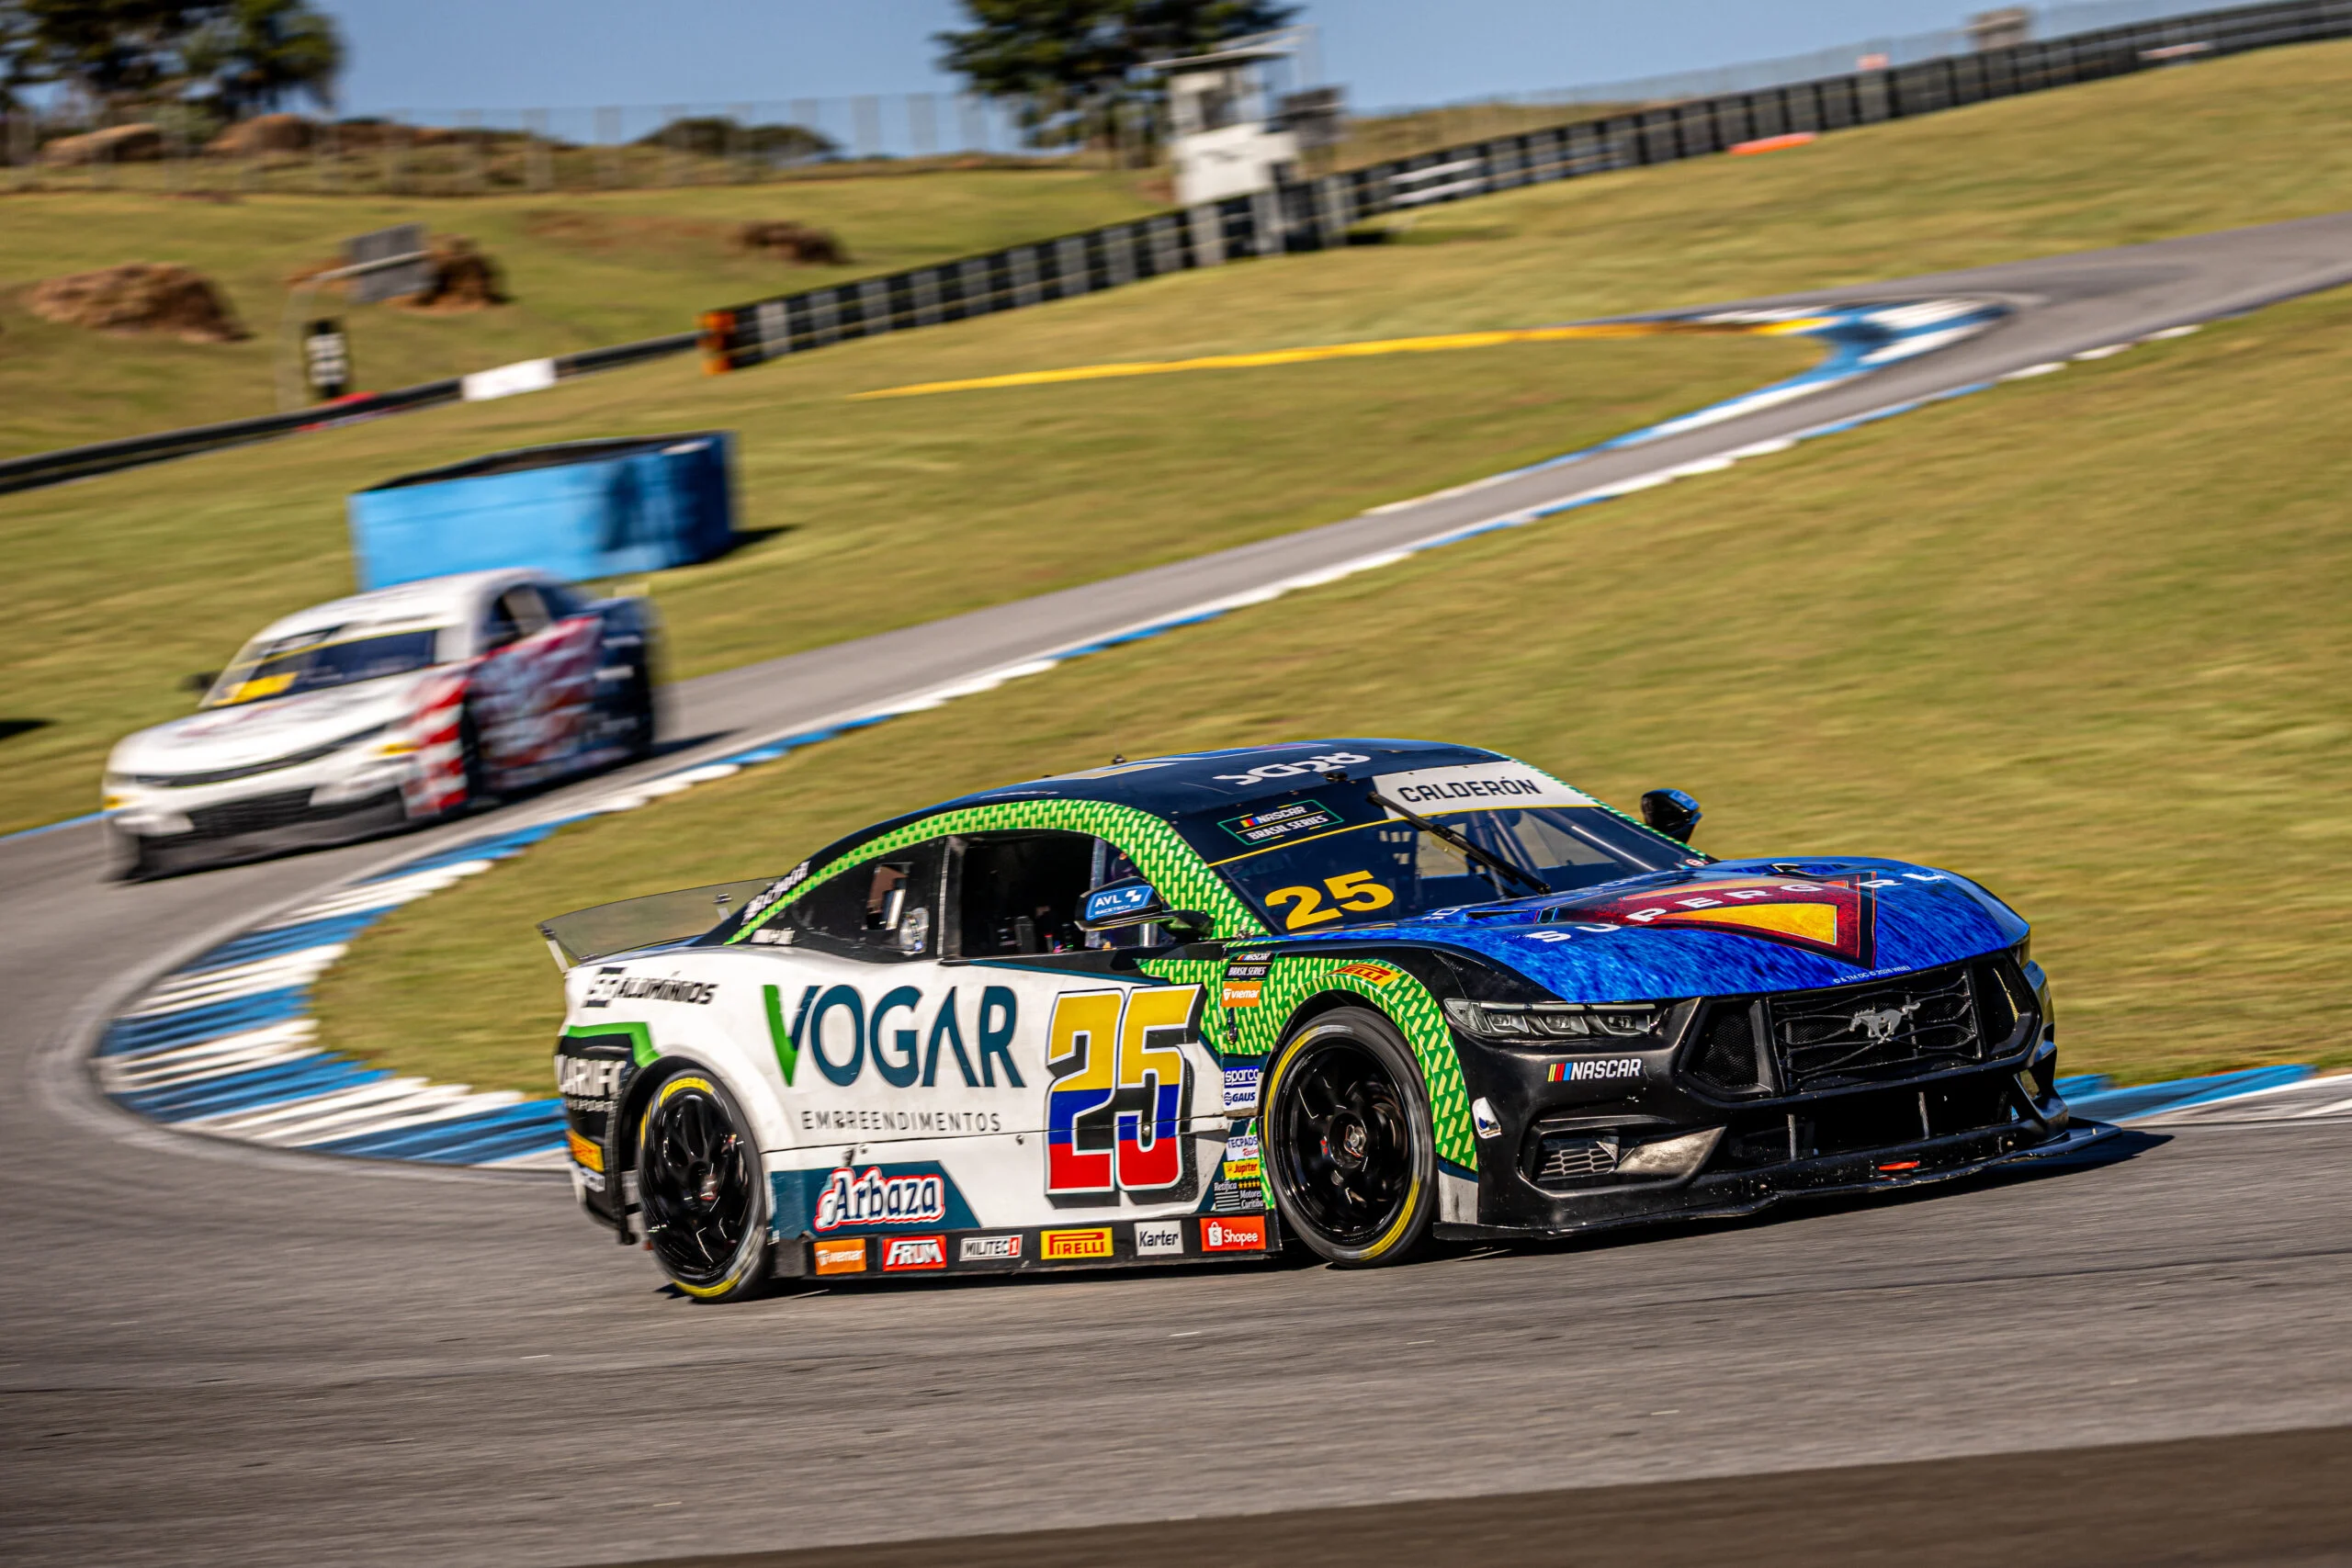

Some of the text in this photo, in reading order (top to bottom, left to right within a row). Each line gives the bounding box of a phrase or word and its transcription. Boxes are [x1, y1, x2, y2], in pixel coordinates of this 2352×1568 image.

[1258, 806, 1307, 824] NASCAR
[1247, 815, 1329, 840] BRASIL SERIES
[1094, 895, 1122, 908] AVL
[1264, 870, 1395, 931] 25
[1227, 966, 1267, 976] BRASIL SERIES
[1231, 989, 1260, 999] viemar
[762, 984, 1027, 1089] VOGAR
[1225, 1068, 1259, 1083] sparco
[1570, 1058, 1642, 1080] NASCAR
[1047, 983, 1203, 1196] 25
[1232, 1092, 1256, 1102] GAUS
[801, 1110, 1002, 1132] EMPREENDIMENTOS
[1227, 1136, 1259, 1148] TECPADS
[816, 1168, 944, 1231] Arbaza
[1048, 1232, 1104, 1256] PIRELLI
[1139, 1231, 1179, 1247] Karter
[1224, 1230, 1259, 1246] Shopee
[886, 1239, 944, 1266] FRUM
